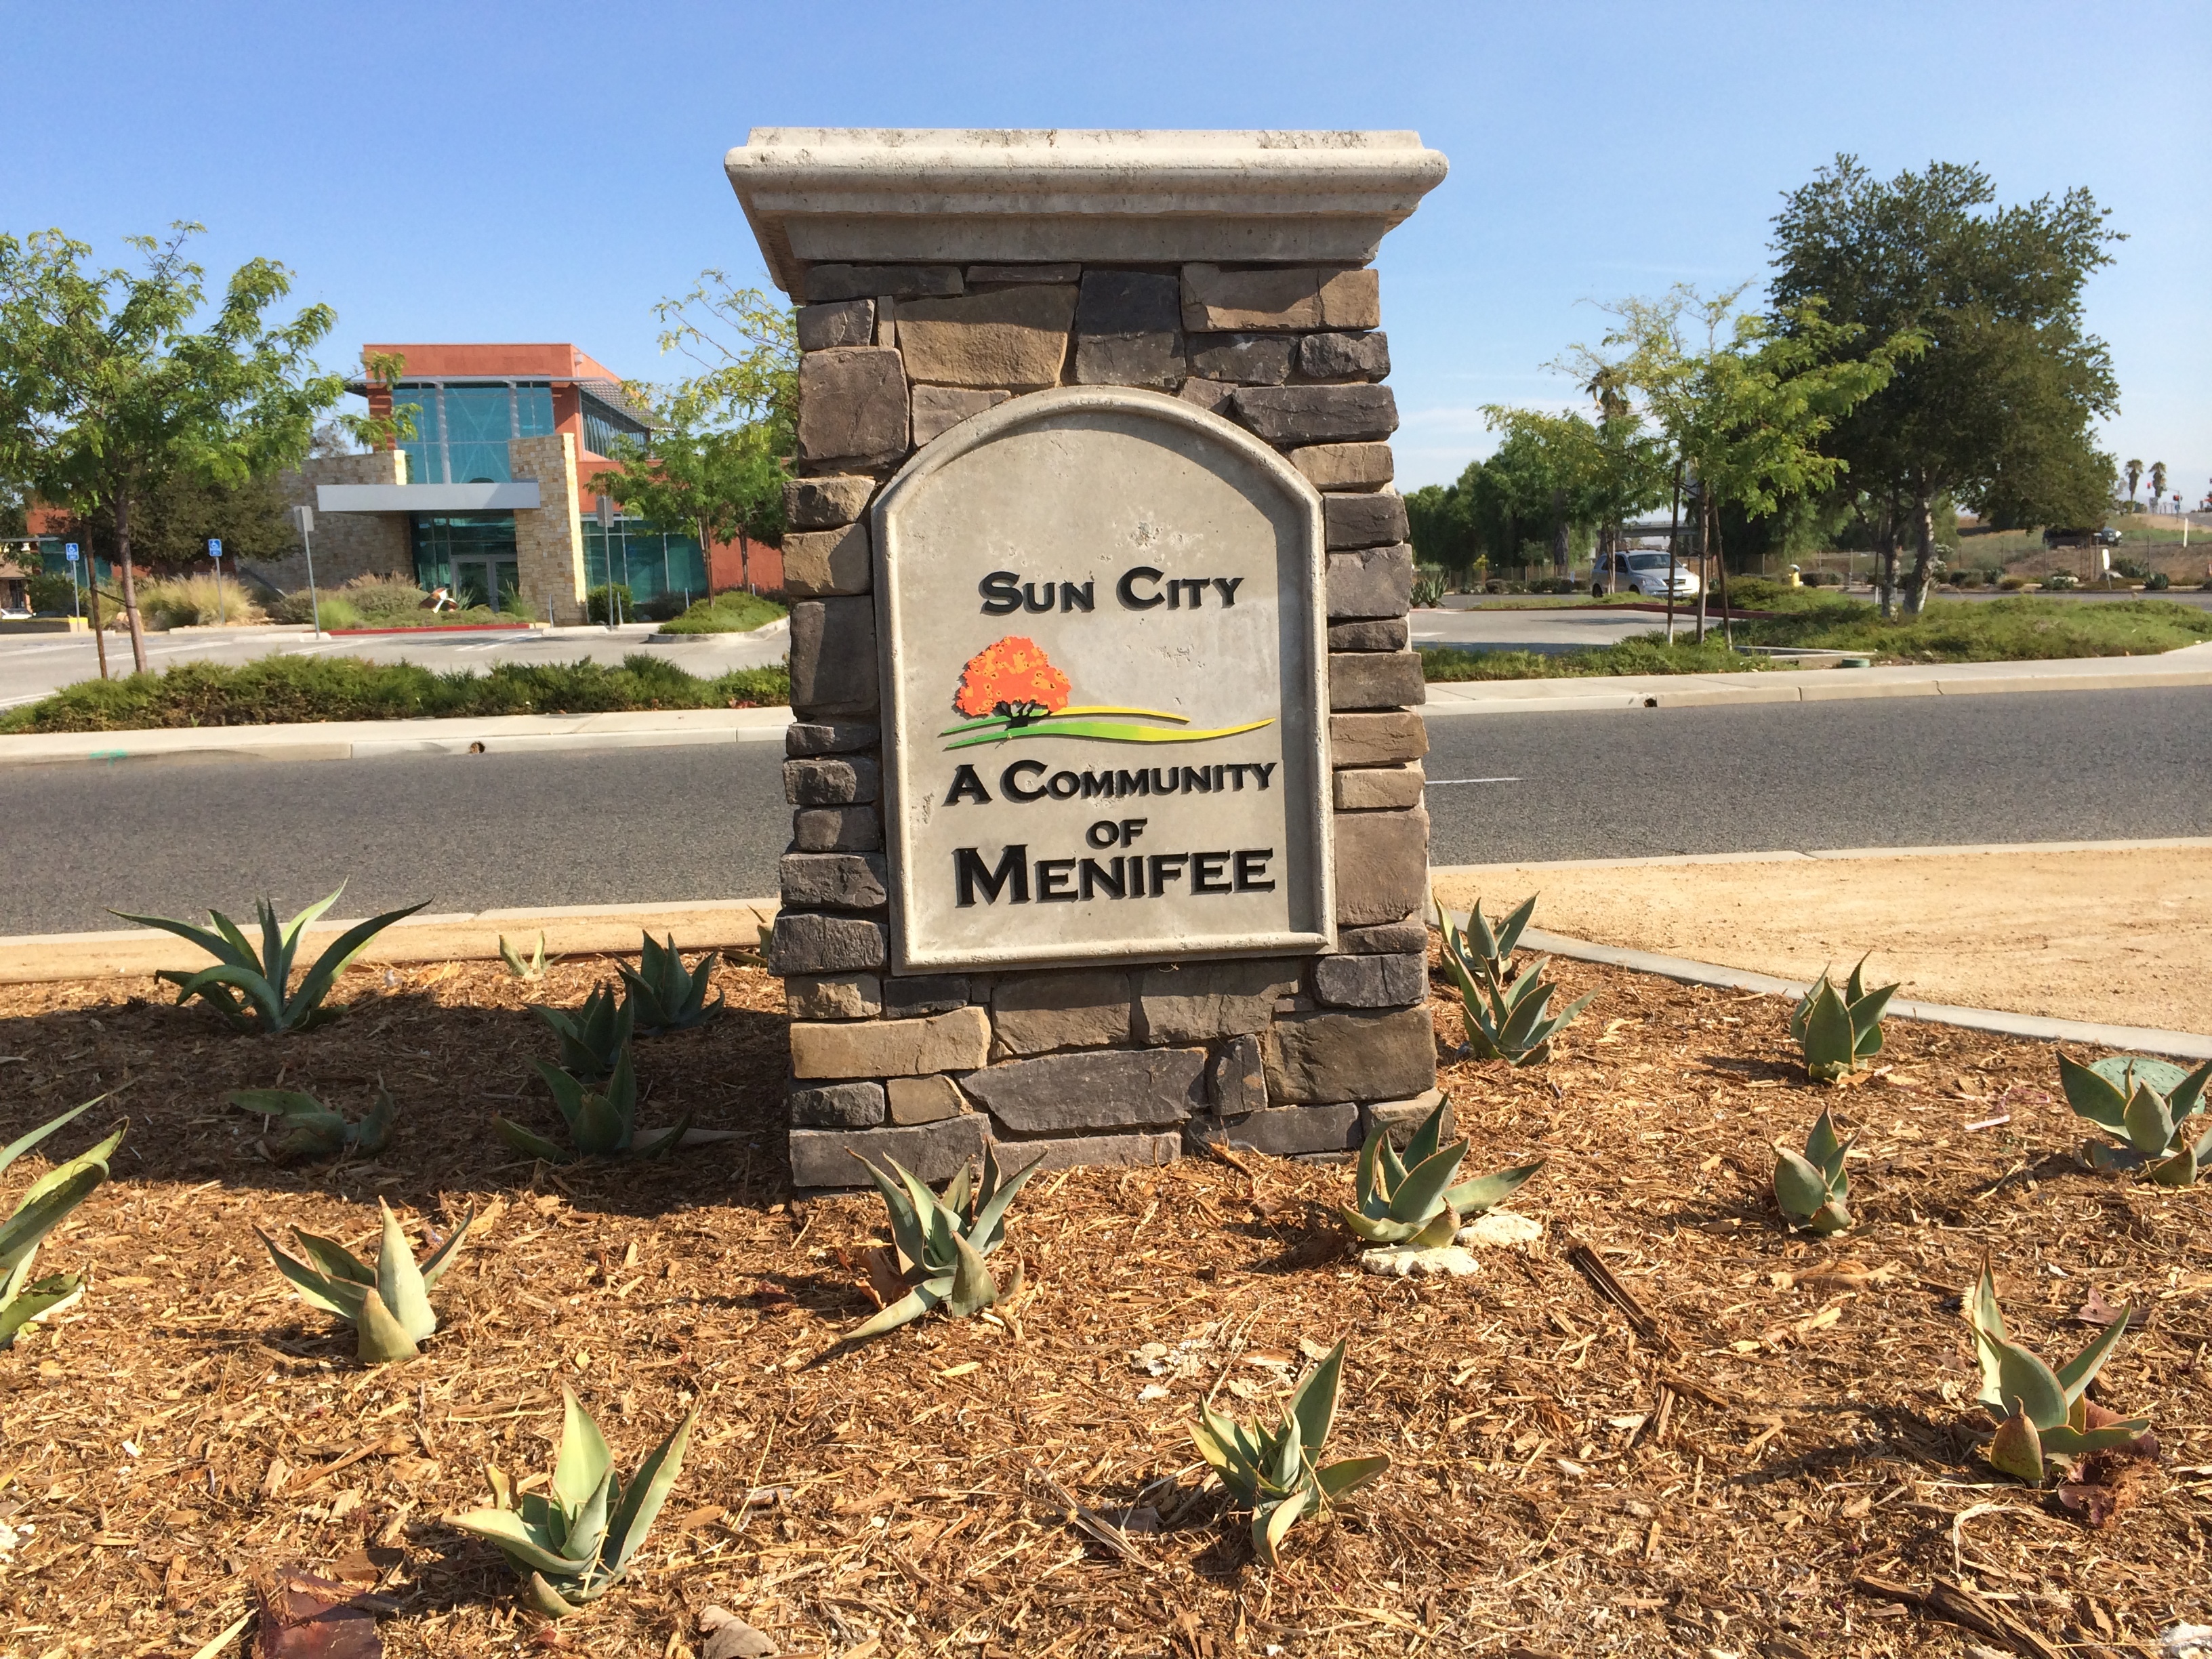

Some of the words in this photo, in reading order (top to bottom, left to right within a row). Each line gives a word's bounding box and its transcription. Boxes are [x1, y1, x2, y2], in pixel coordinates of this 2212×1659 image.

[978, 571, 1096, 613] SUN
[1116, 566, 1245, 610] CITY
[942, 764, 994, 806] A
[1000, 759, 1277, 804] COMMUNITY
[1086, 817, 1148, 849] OF
[951, 844, 1277, 908] MENIFEE
